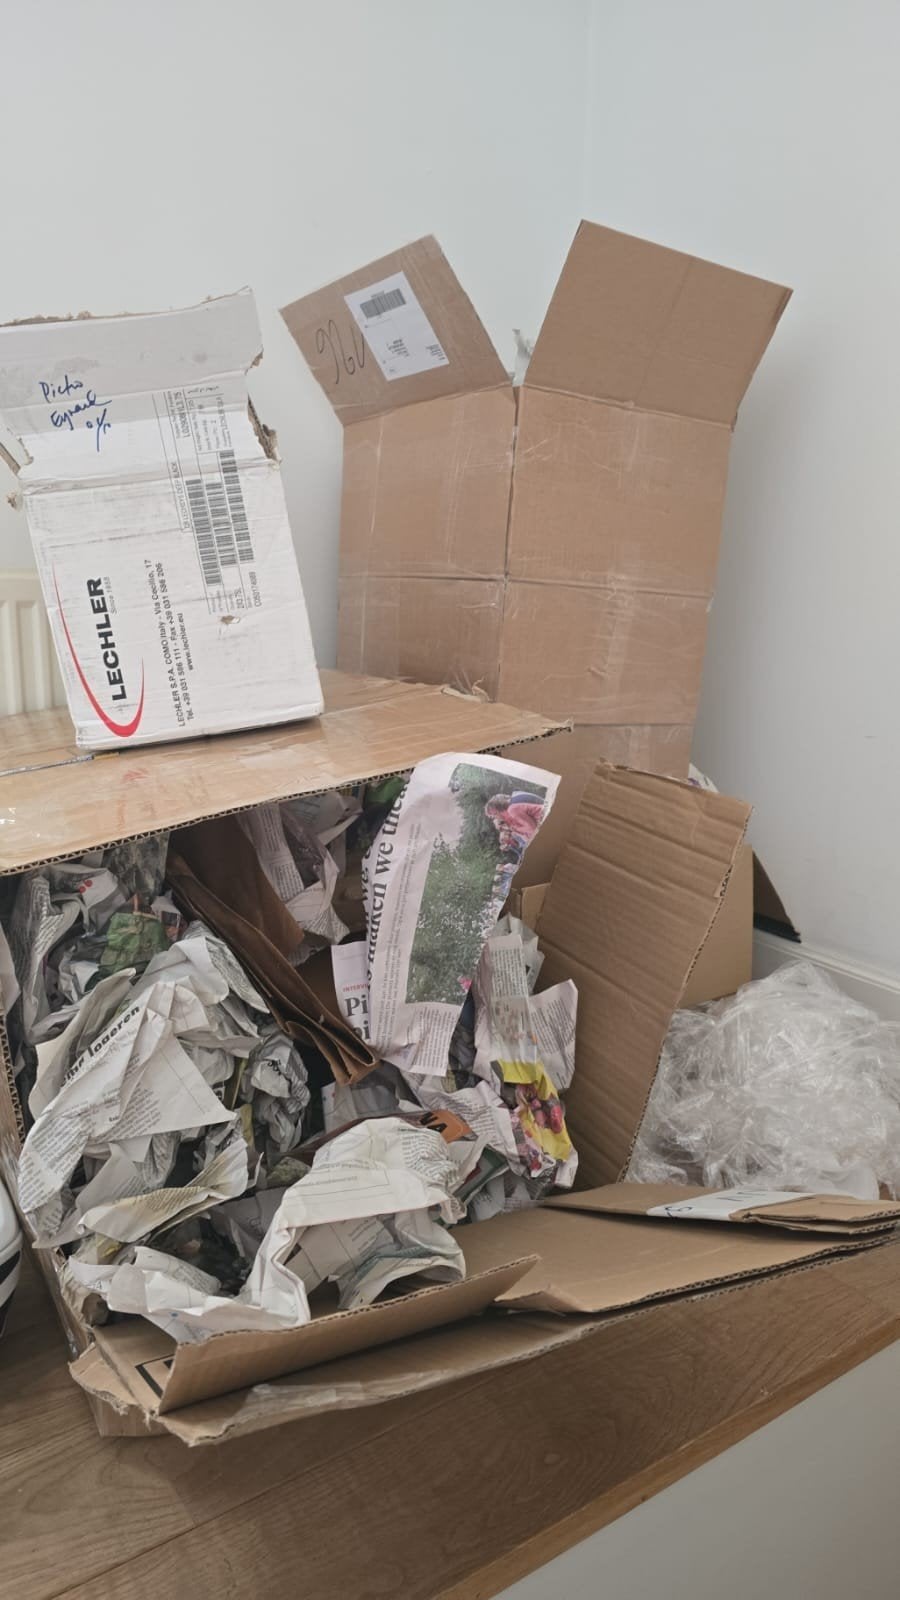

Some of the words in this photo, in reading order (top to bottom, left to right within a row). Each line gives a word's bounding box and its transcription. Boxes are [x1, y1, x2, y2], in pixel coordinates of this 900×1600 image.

[144, 559, 153, 569] 17
[154, 601, 162, 615] Via
[162, 595, 172, 609] 031
[165, 610, 175, 625] +39
[158, 621, 167, 638] Italy
[170, 626, 178, 641] Fax
[86, 577, 127, 700] LECHLER
[176, 612, 194, 671] www.lechler.eu
[161, 639, 173, 665] COMO
[173, 648, 181, 660] 111
[180, 678, 188, 691] 031
[183, 692, 191, 706] +39
[172, 690, 186, 727] LECHLER
[374, 841, 394, 876] we
[344, 994, 369, 1017] Pi
